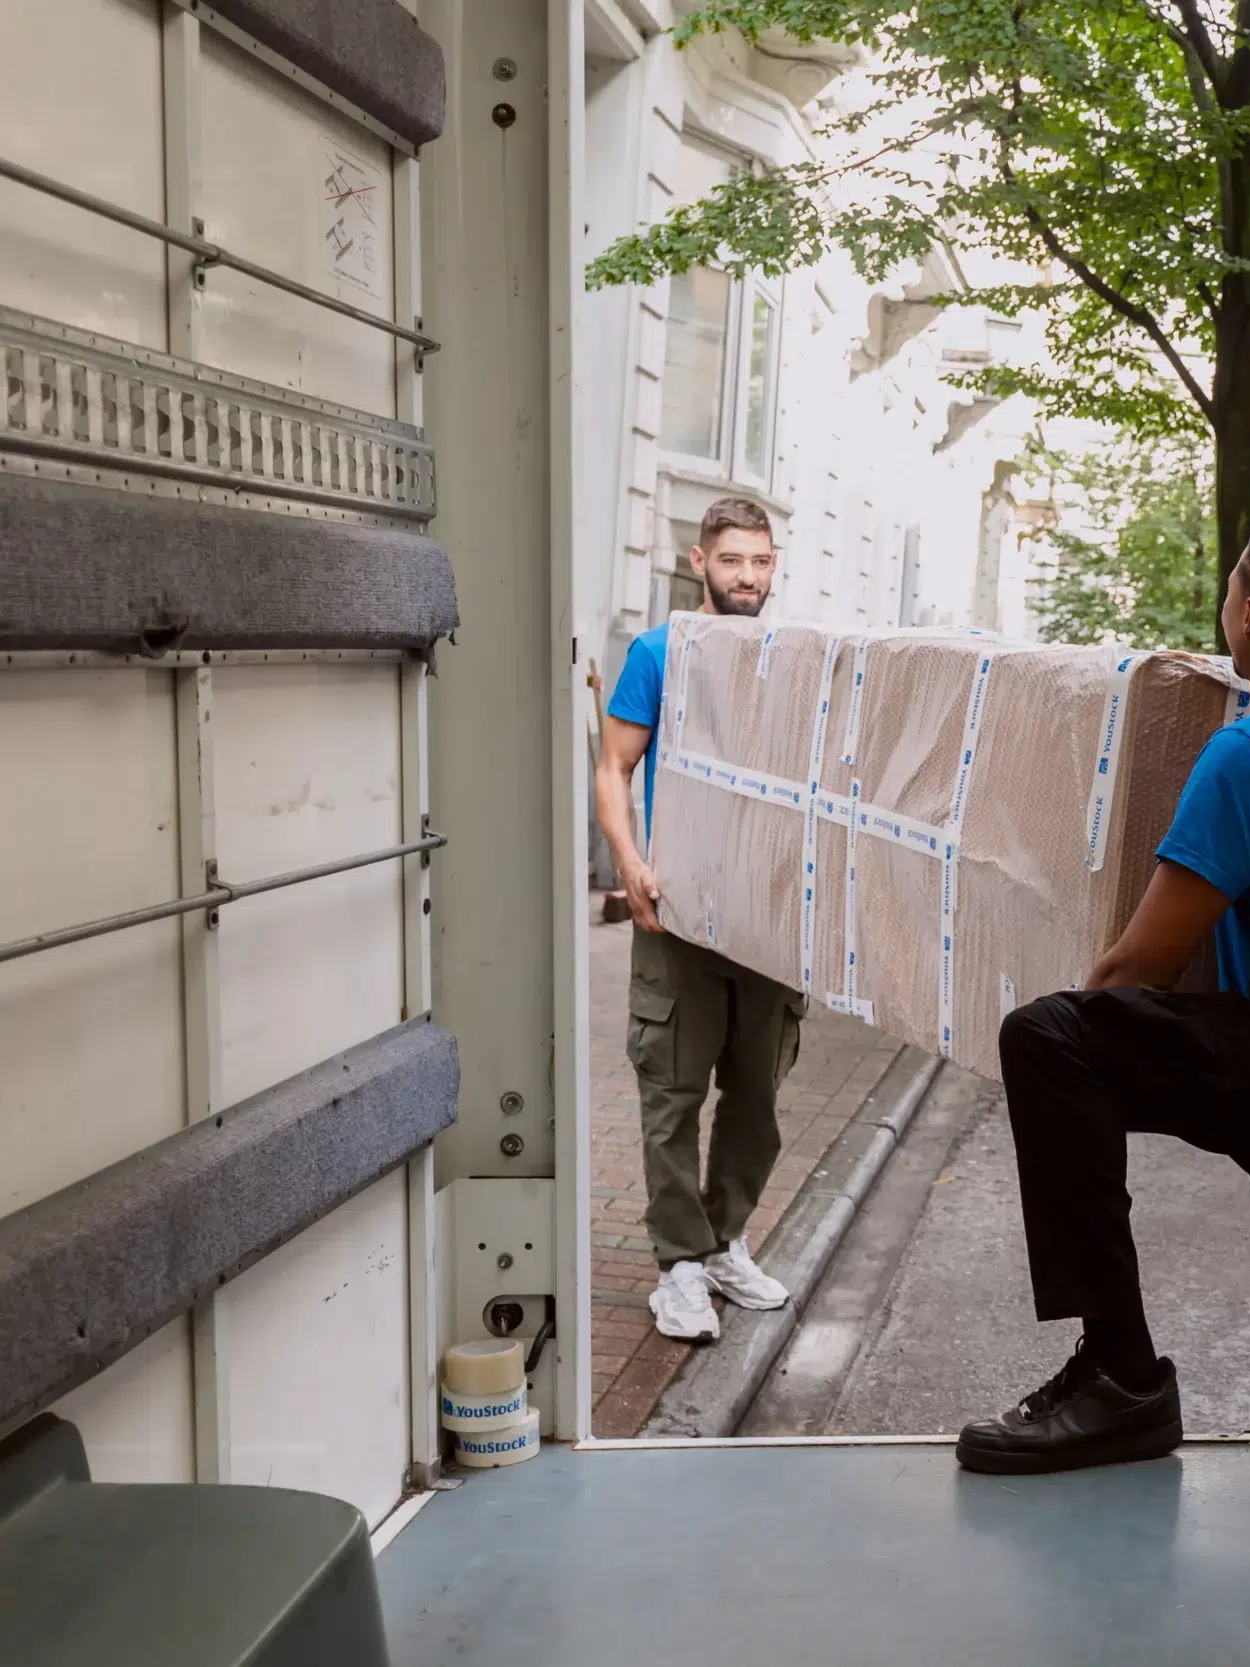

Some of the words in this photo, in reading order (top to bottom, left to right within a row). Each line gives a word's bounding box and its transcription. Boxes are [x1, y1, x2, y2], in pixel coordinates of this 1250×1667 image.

[1103, 695, 1119, 753] YouStock
[457, 1399, 520, 1418] YouStock
[462, 1436, 527, 1454] YouStock
